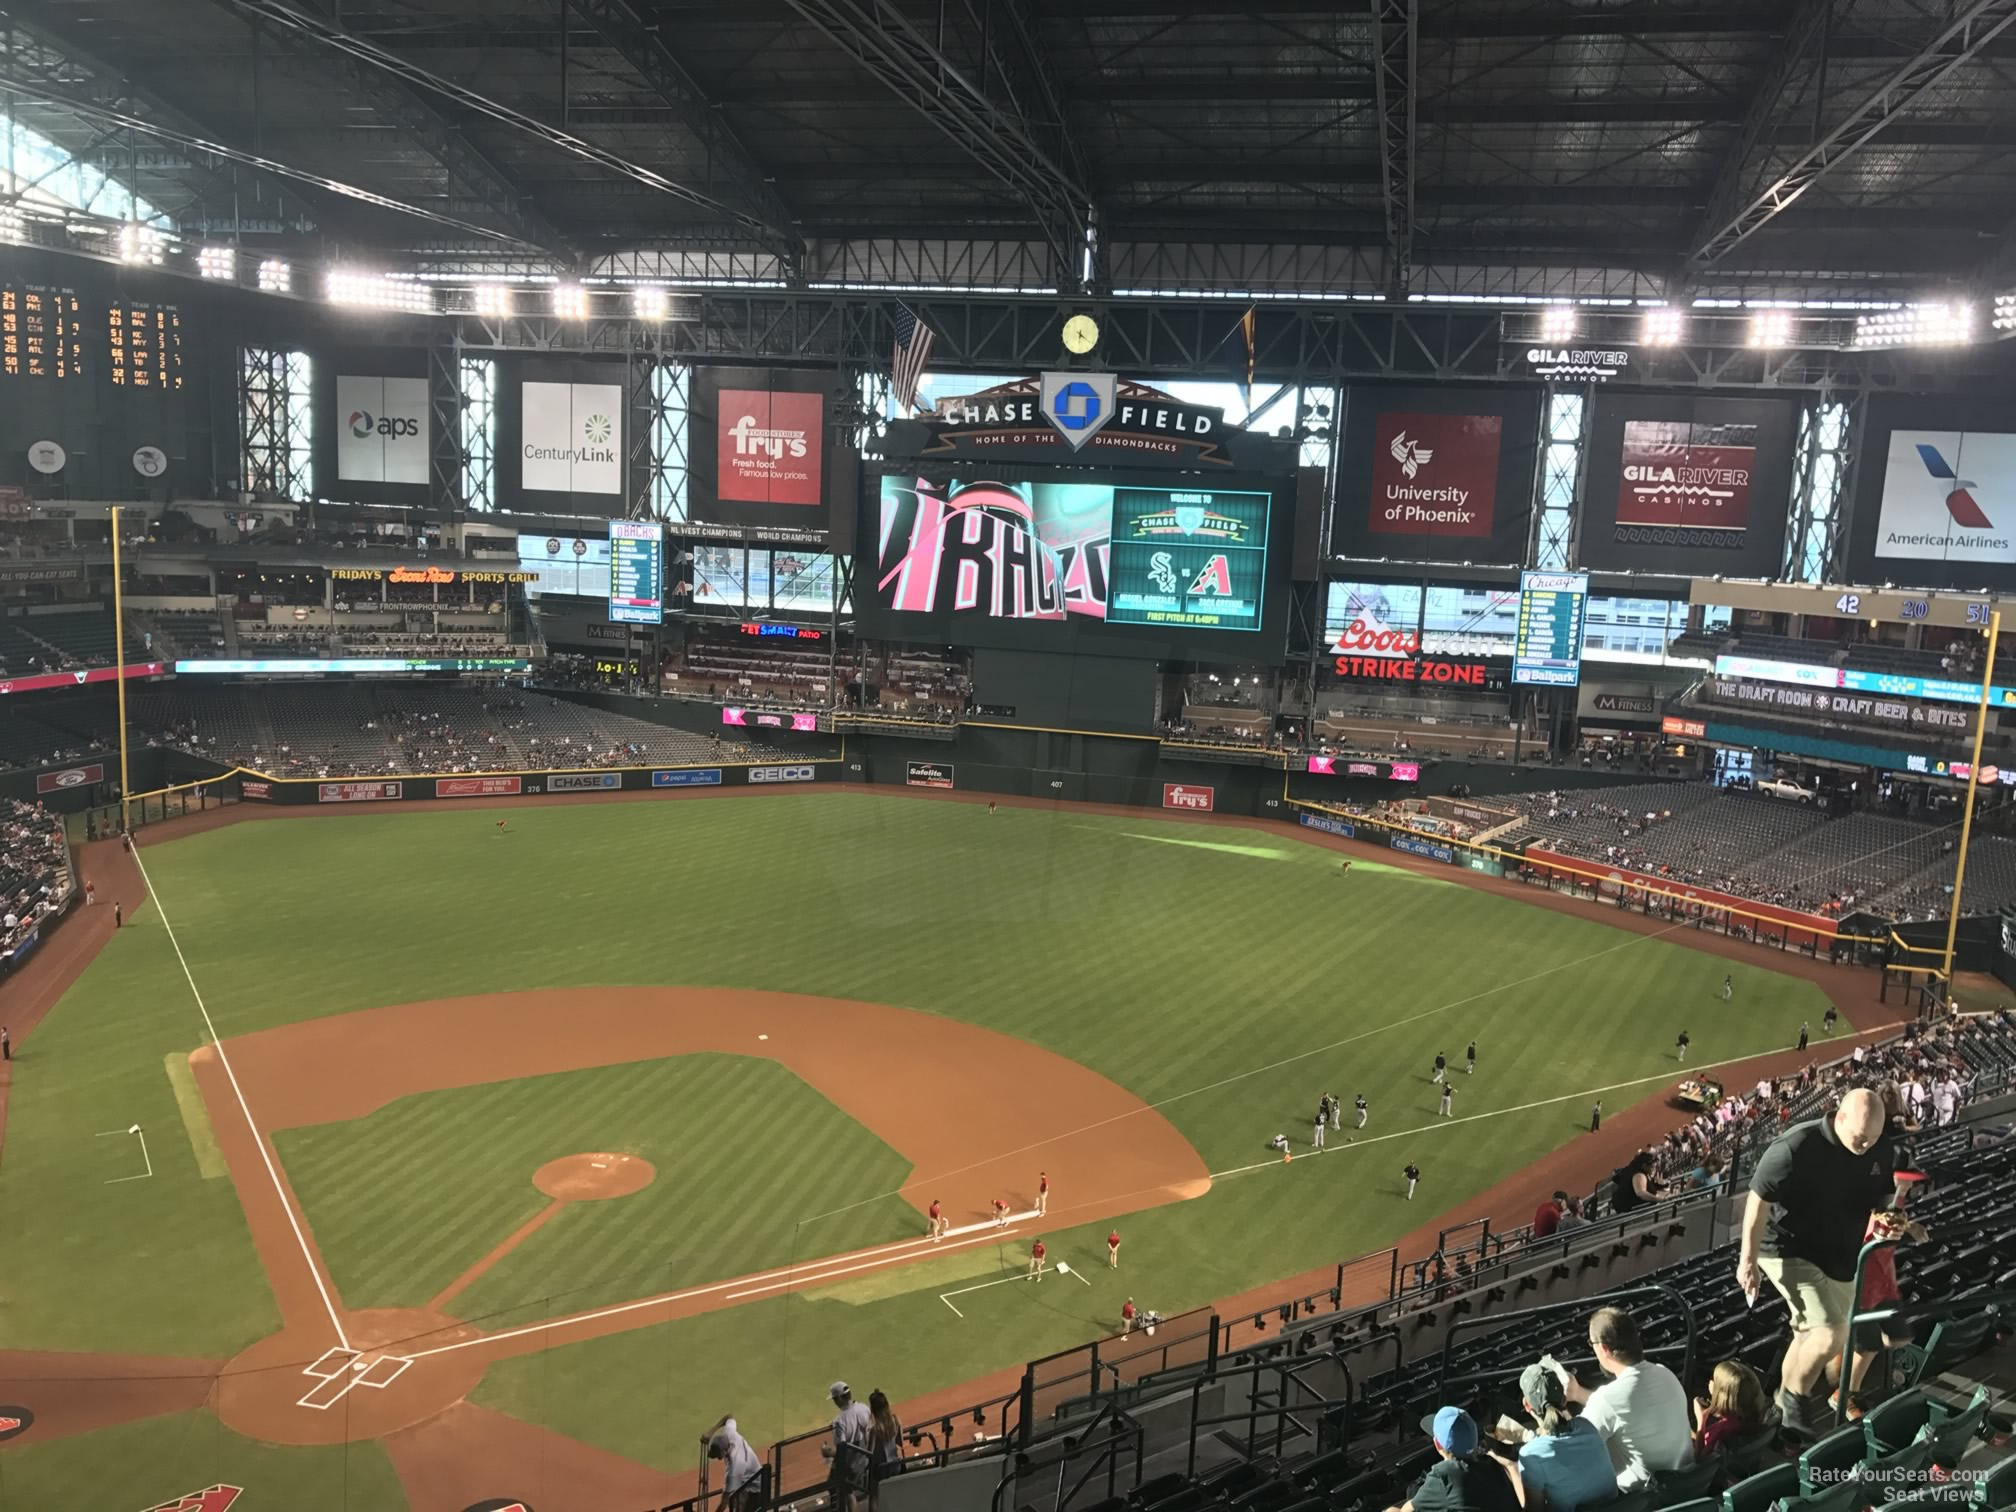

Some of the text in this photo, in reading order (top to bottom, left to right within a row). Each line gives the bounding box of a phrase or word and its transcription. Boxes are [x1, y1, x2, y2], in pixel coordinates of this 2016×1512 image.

[2, 292, 15, 301] 34
[54, 296, 61, 304] 4
[109, 309, 121, 317] 44
[4, 323, 16, 332] 53
[56, 326, 62, 335] 3
[110, 328, 122, 337] 51
[159, 332, 164, 340] 2
[4, 335, 16, 344] 45
[28, 337, 43, 345] PIT
[111, 337, 122, 345] 43
[159, 340, 164, 348] 3
[4, 344, 80, 356] 26 ATL 2 5
[159, 352, 165, 360] 2
[5, 356, 64, 368] 50 4
[160, 360, 165, 368] 2
[5, 366, 18, 374] 41
[74, 366, 80, 374] 4
[112, 368, 124, 377] 32
[112, 377, 124, 385] 41
[945, 403, 1212, 434] CHASE FIELD
[377, 416, 418, 440] aps
[728, 415, 807, 460] fry's
[976, 435, 1177, 452] HOME OF THE DIAMONDBACKS
[524, 444, 614, 464] CenturyLink
[732, 459, 777, 469] Fresh food.
[739, 468, 808, 481] Famous low prices.
[1170, 494, 1212, 504] WELCOME TO
[1387, 484, 1469, 505] University
[1638, 496, 1723, 507] CASINOS
[1385, 505, 1471, 523] of Phoenix
[1141, 517, 1238, 531] CHASE FIELD
[671, 526, 742, 538] NL WEST CHAMPIONS
[757, 532, 822, 543] WORLD CHAMPIONS
[1887, 531, 2009, 549] American Airlines
[331, 570, 382, 580] FRIDAYS
[462, 573, 505, 583] SPORTS
[1528, 575, 1577, 592] Chicago
[1836, 595, 1859, 614] 42
[1902, 600, 1928, 618] 20
[624, 609, 659, 621] Ballpark
[1147, 612, 1164, 621] FIRST
[1166, 613, 1185, 622] PITCH
[1186, 614, 1194, 622] AT
[1966, 603, 1990, 624] 51
[588, 626, 601, 637] M
[799, 630, 820, 639] PATIO
[1338, 619, 1498, 657] Coors LIGHT
[1336, 657, 1486, 684] STRIKE ZONE
[1531, 669, 1575, 683] Ballpark
[1600, 696, 1616, 709] M
[1618, 700, 1652, 712] FITNESS
[1715, 682, 1967, 727] THE DRAFT ROOM CRAFT BEER & BITES
[670, 774, 687, 782] pepsi
[750, 767, 814, 782] GEICO
[910, 768, 942, 777] Safelite
[554, 777, 600, 788] CHASE
[1169, 787, 1208, 808] fry's
[1454, 806, 1482, 820] RAM TRUCKS
[1307, 816, 1331, 830] LESLIE'S
[1396, 839, 1449, 860] COX COX COX
